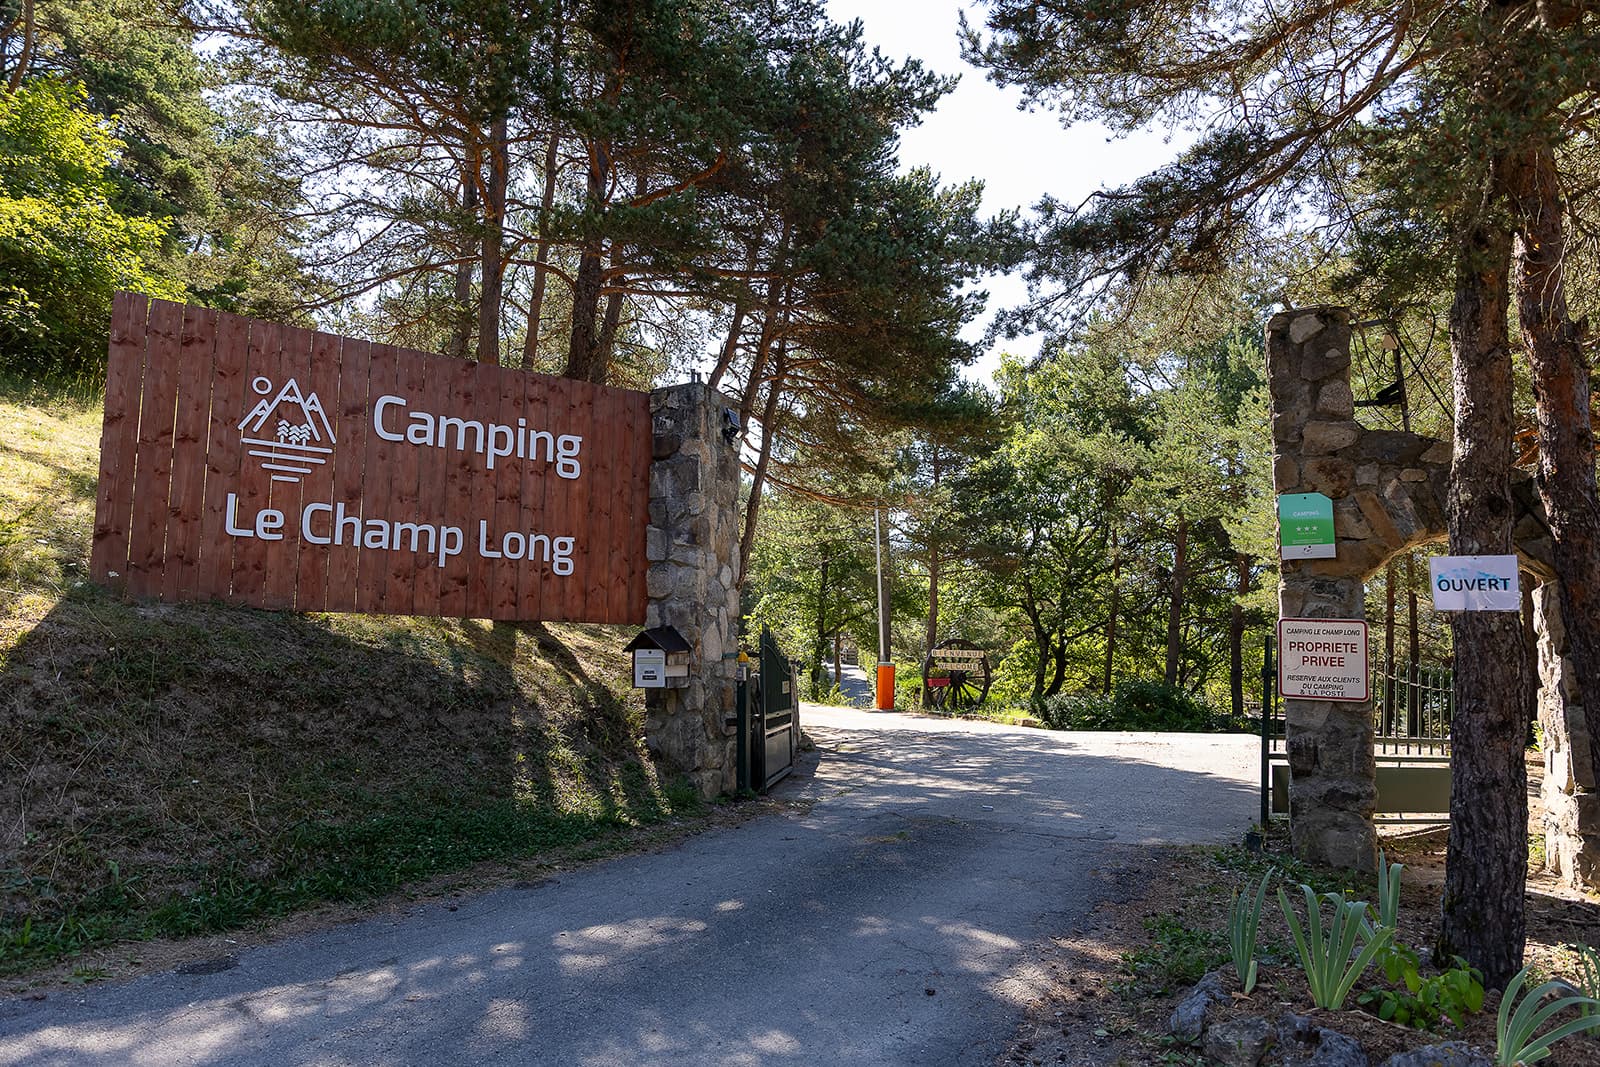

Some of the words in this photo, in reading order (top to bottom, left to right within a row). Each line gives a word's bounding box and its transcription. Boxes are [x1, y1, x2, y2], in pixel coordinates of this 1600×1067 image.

[373, 394, 583, 480] Camping
[224, 493, 285, 540] Le
[302, 502, 464, 568] Champ
[480, 519, 575, 576] Long
[1437, 577, 1511, 592] OUVERT
[1289, 641, 1358, 653] PROPRIETE
[937, 662, 979, 670] WELCOME
[1302, 656, 1345, 667] PRIVEE
[1287, 674, 1317, 682] RESERVE
